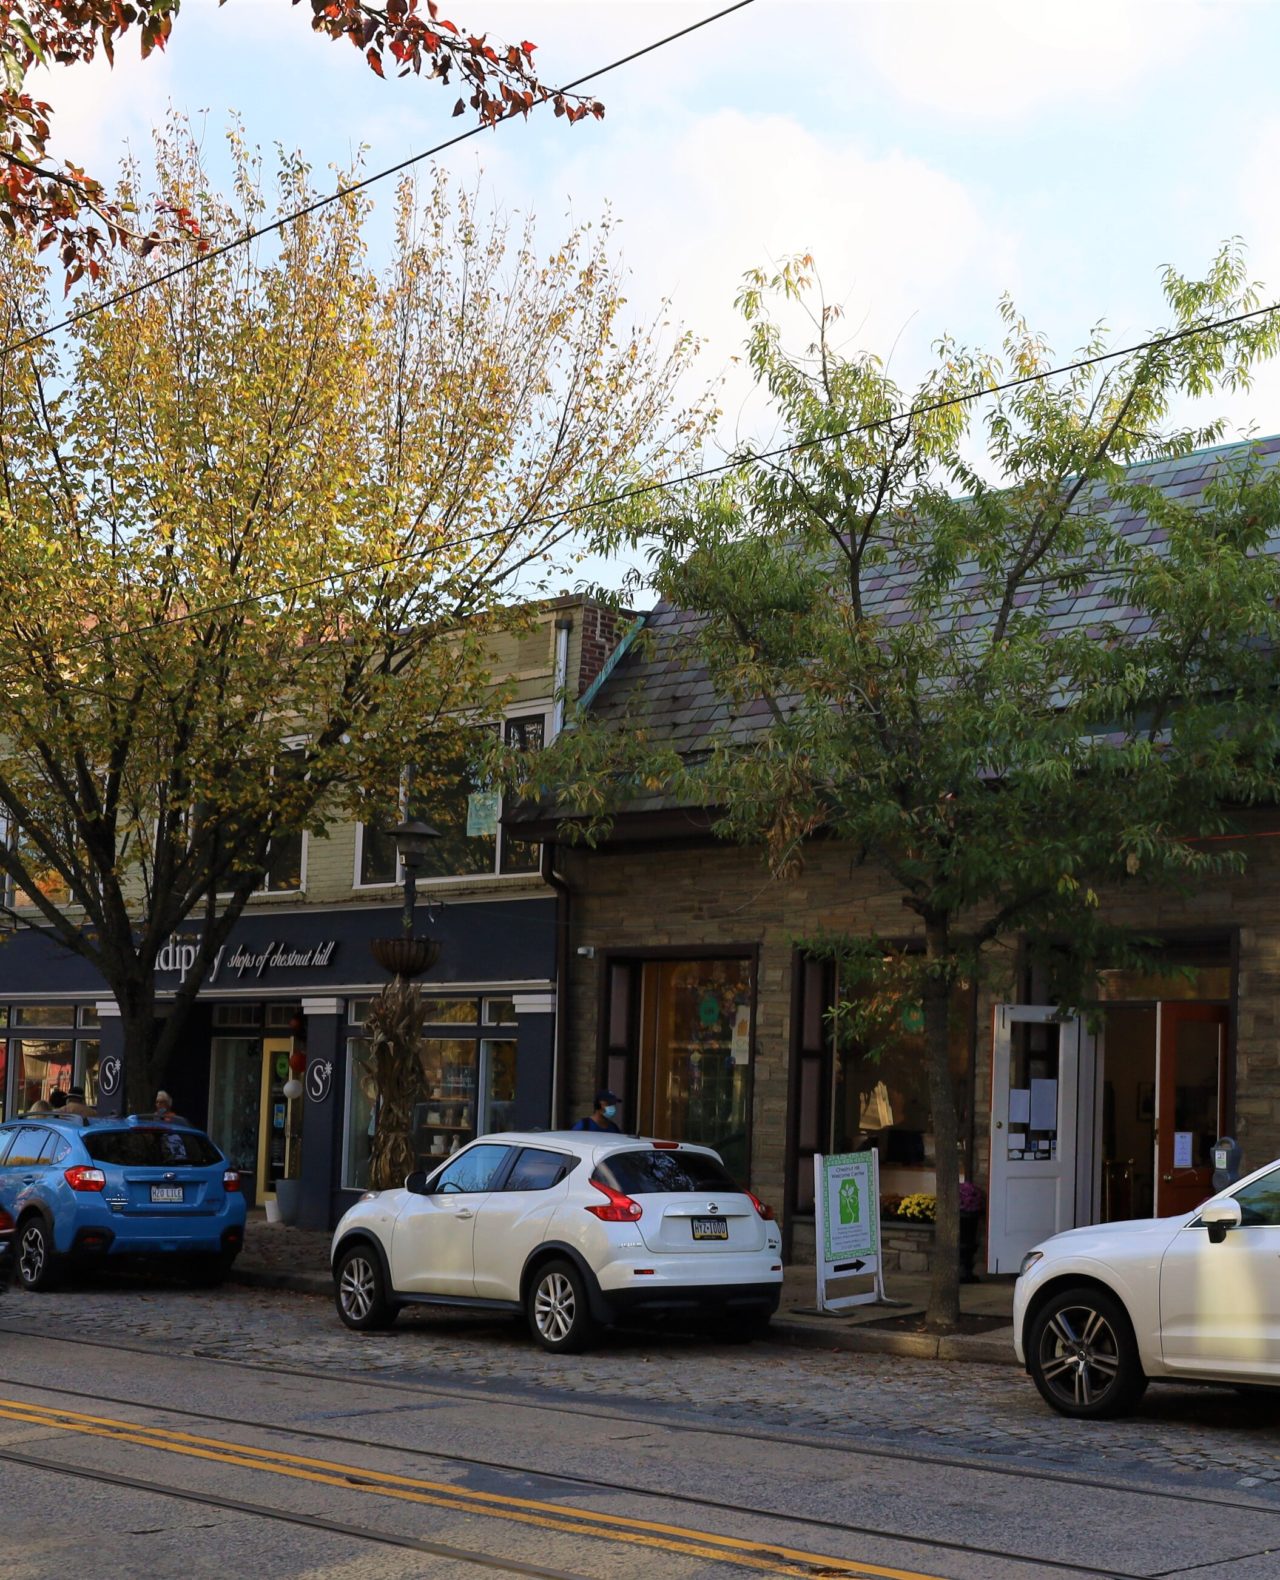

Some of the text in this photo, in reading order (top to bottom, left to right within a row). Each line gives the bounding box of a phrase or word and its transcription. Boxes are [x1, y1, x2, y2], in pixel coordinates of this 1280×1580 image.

[227, 945, 255, 978] shops
[256, 941, 275, 978] of
[270, 943, 313, 967] chestnut
[312, 941, 336, 966] hill
